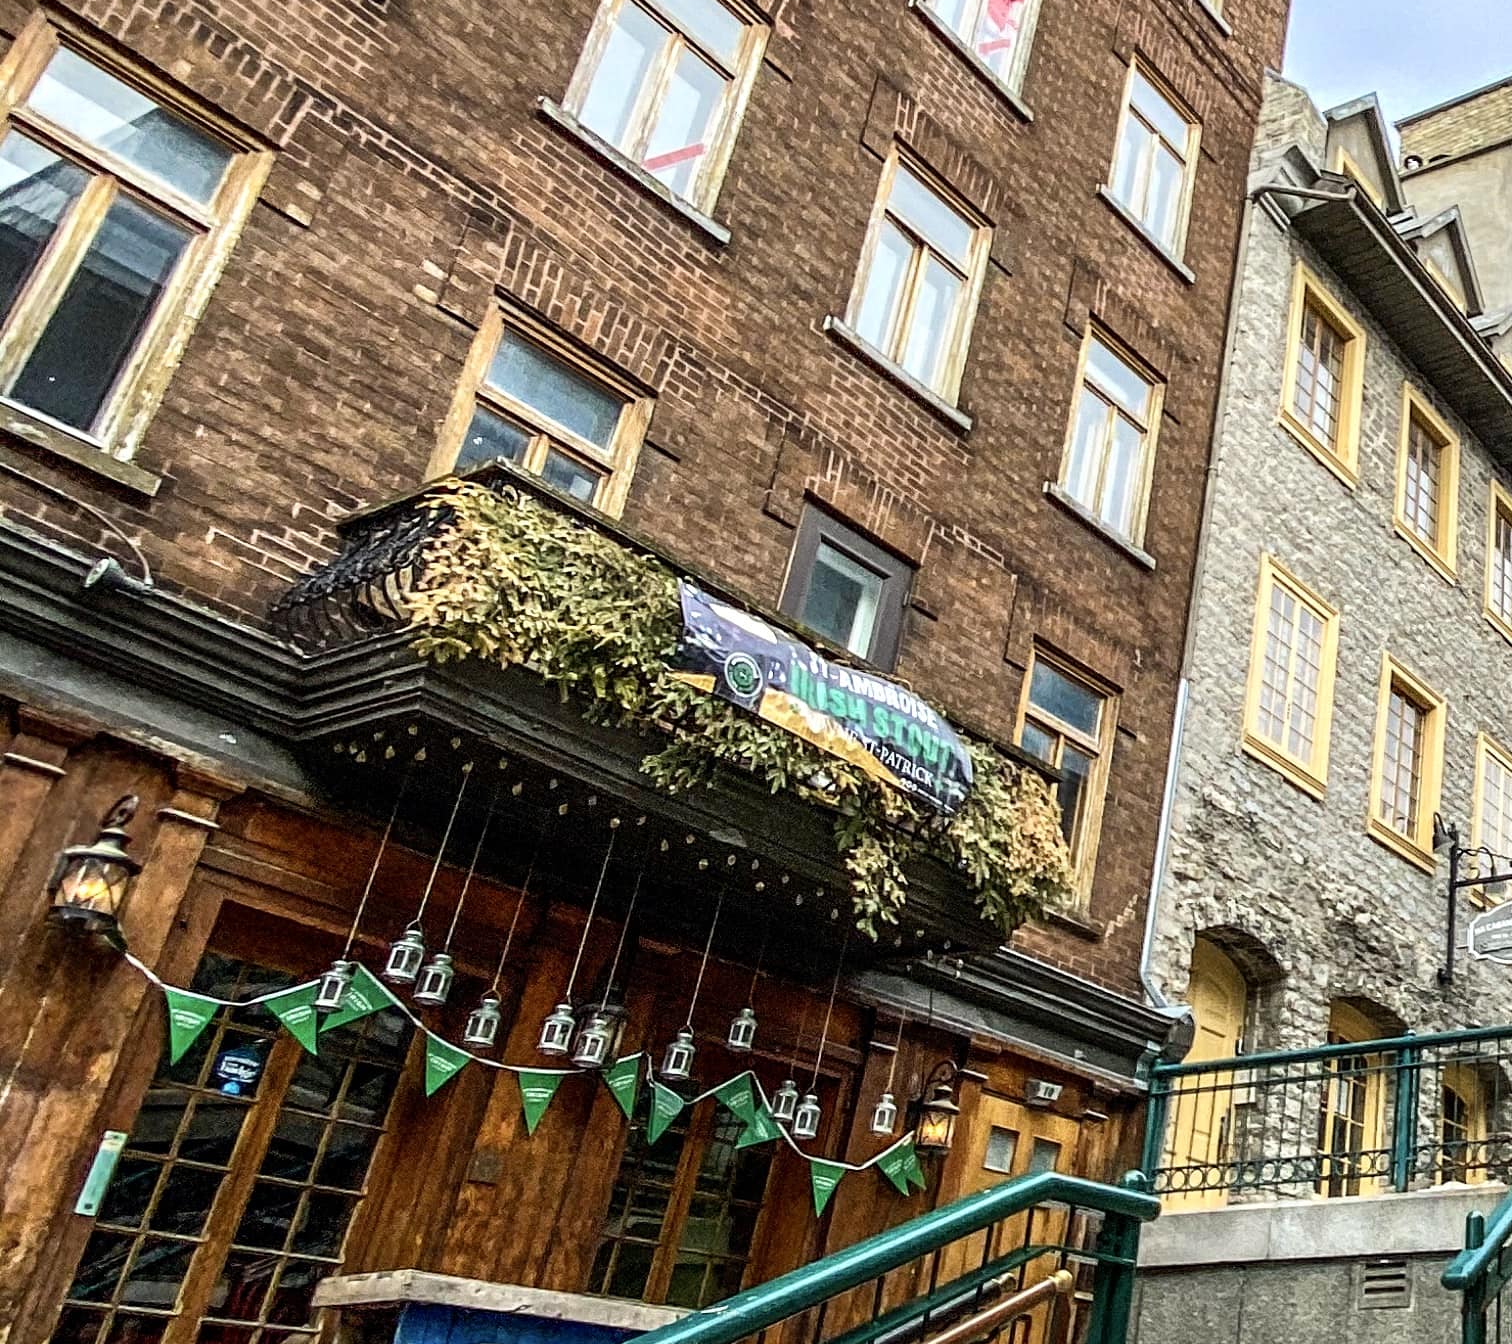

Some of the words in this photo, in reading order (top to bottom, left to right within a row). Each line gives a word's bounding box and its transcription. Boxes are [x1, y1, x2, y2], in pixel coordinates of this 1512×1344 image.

[789, 660, 868, 728] IRISH
[872, 707, 954, 773] STOUT
[809, 651, 939, 730] ST-AMBROISE
[861, 739, 935, 787] ST-PATRICK
